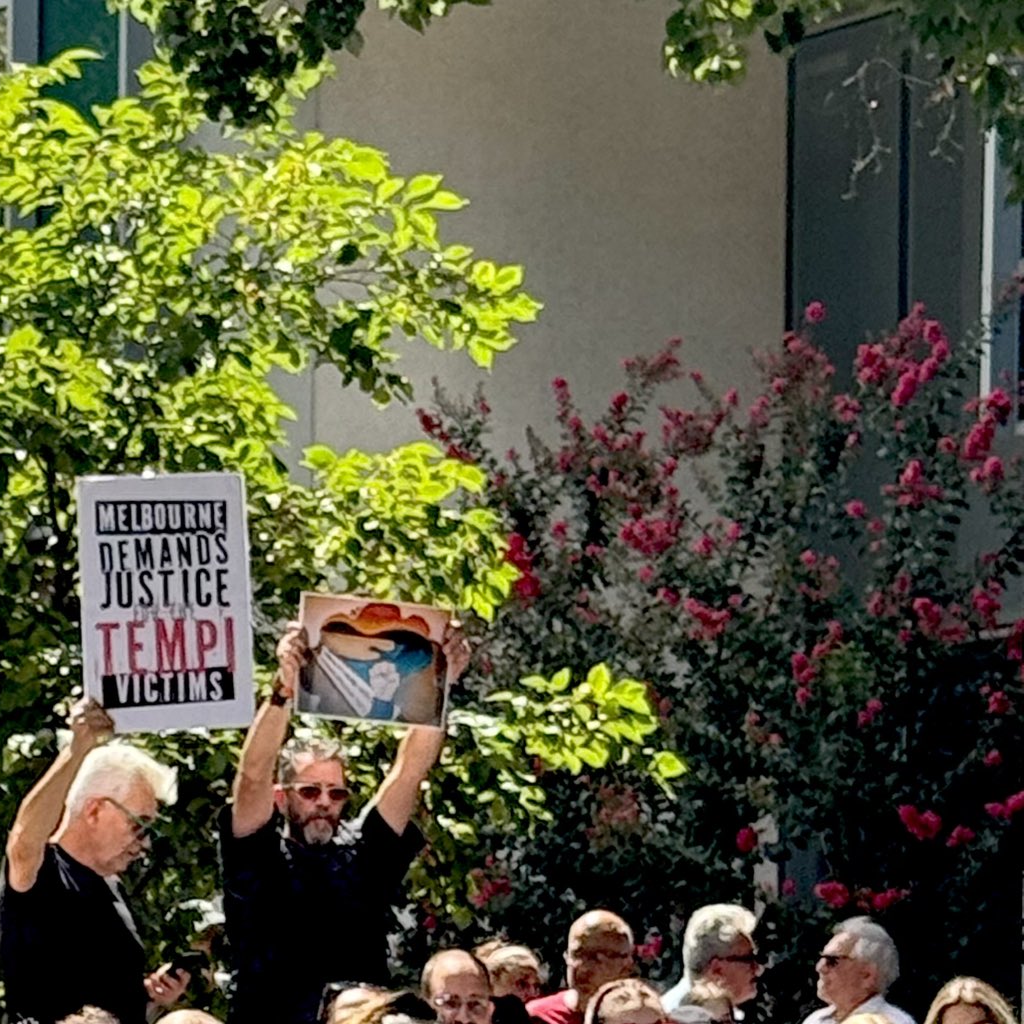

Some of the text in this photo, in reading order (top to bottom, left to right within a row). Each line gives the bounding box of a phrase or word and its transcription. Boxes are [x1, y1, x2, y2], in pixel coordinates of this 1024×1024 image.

[97, 502, 224, 533] MELBOURNE
[98, 533, 228, 572] DEMANDS
[100, 569, 230, 609] JUSTICE
[95, 617, 236, 676] TEMPI
[115, 670, 223, 704] VICTIMS
